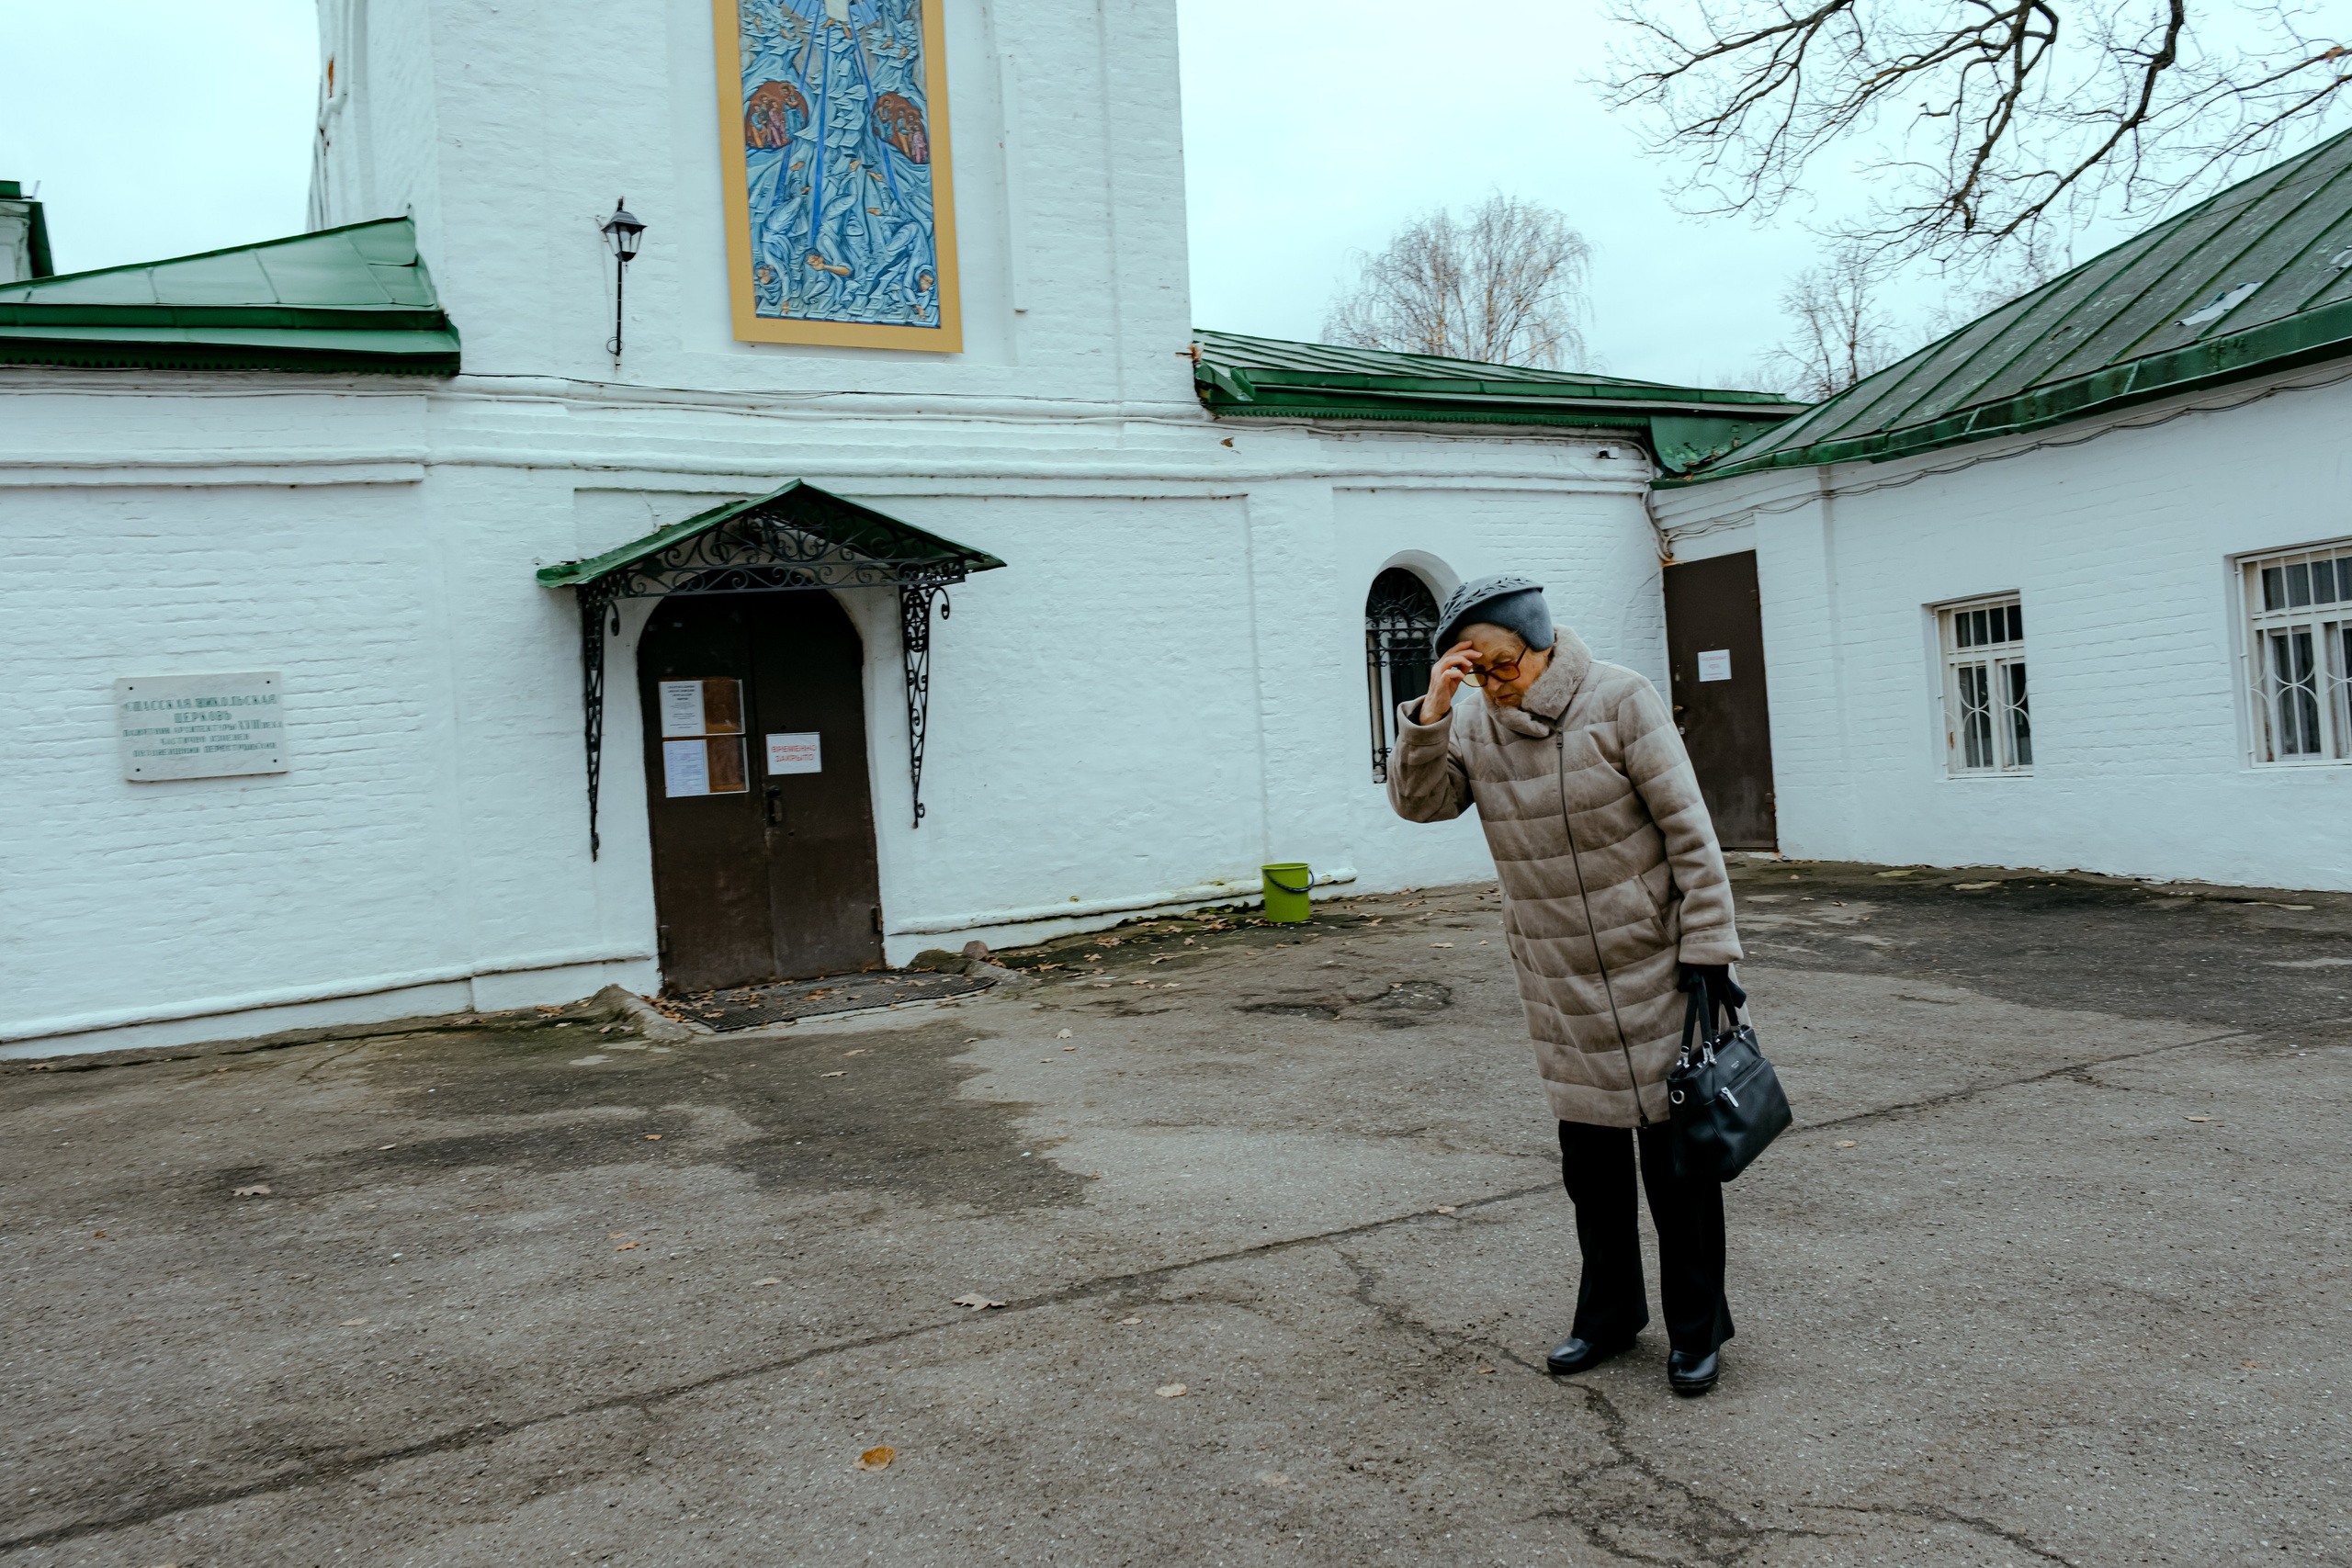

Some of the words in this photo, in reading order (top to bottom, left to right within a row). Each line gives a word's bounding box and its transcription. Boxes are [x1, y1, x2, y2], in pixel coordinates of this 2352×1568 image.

[174, 711, 232, 724] ЦЕРКОВЬ
[174, 723, 237, 734] АРХИТЕКТУРЫ
[772, 744, 817, 753] ВРЕМЕННО
[775, 753, 814, 762] ЗАКРЫТО
